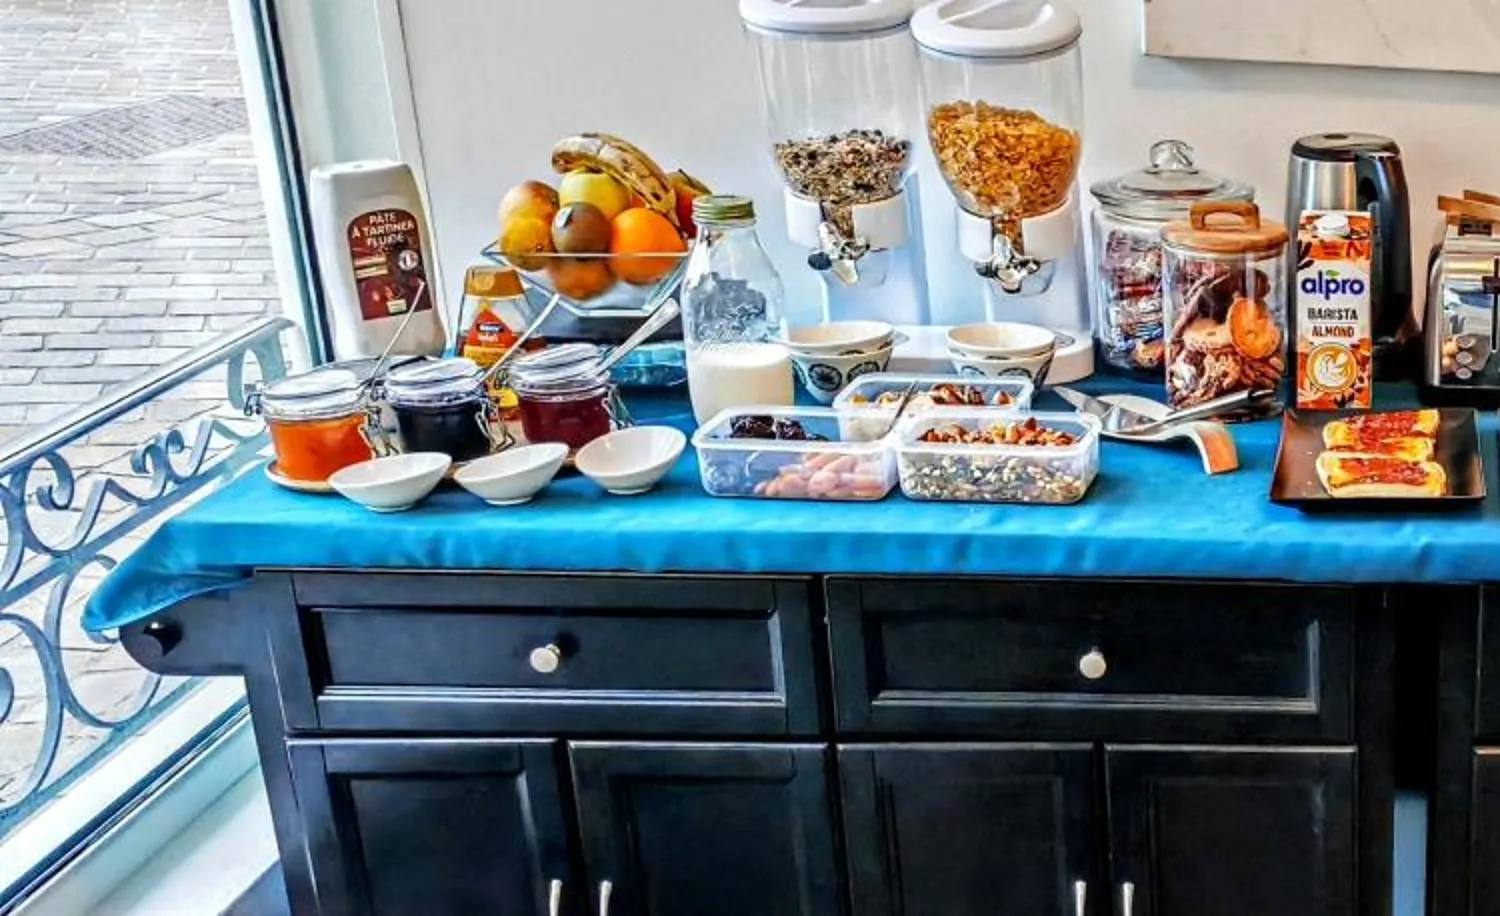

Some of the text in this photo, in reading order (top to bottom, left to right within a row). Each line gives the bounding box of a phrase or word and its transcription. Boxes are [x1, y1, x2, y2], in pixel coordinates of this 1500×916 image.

[1301, 270, 1365, 300] alpro
[1307, 307, 1358, 321] BARISTA
[1311, 324, 1354, 338] ALMOND
